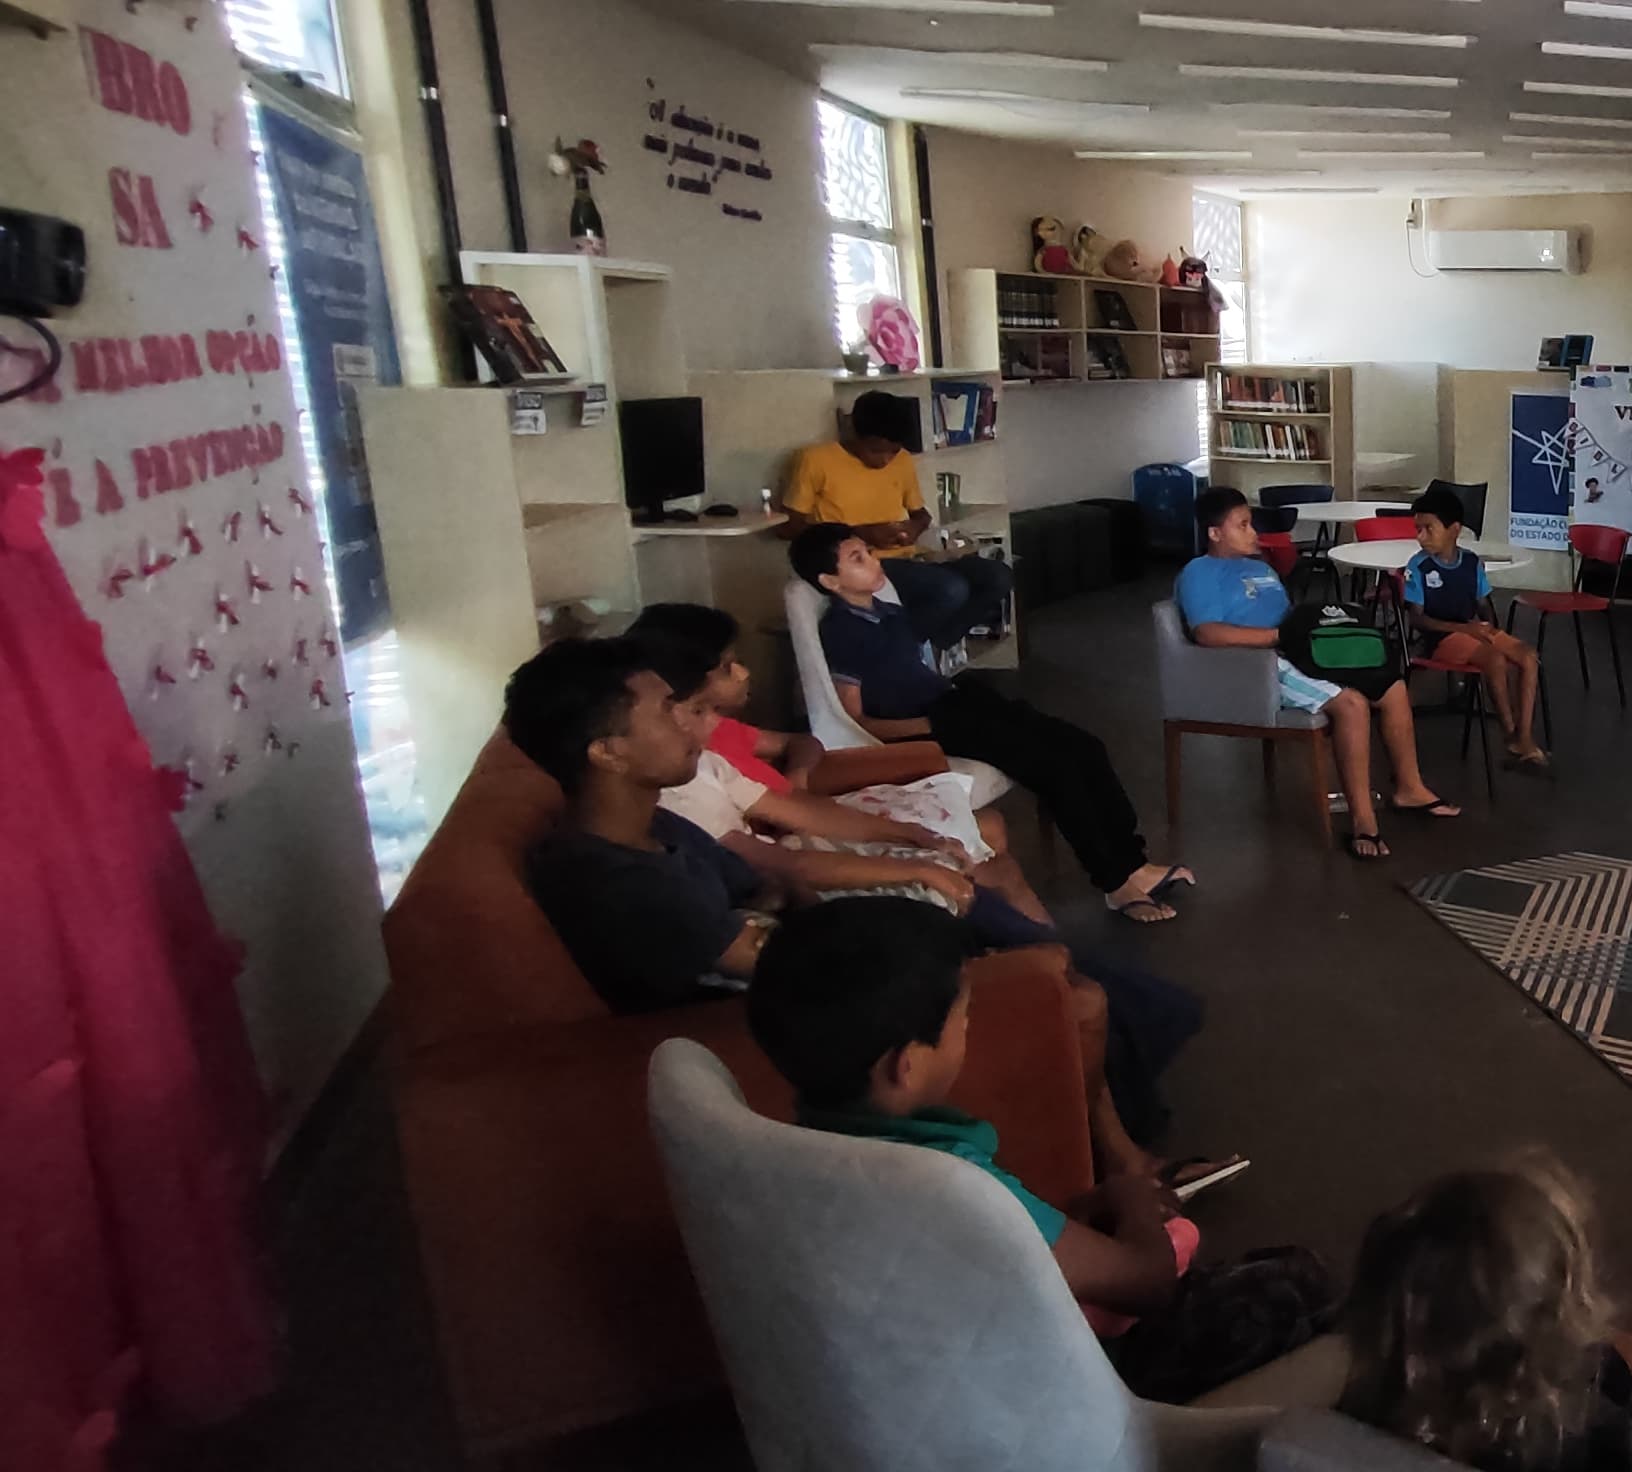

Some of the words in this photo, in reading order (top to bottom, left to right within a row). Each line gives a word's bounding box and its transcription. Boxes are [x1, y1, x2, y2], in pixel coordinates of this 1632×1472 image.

[89, 32, 191, 137] BRO
[107, 165, 175, 250] SA
[69, 332, 204, 394] MELHOR
[94, 457, 126, 515] A
[1510, 516, 1558, 530] FUNDAÇÃO
[1510, 529, 1524, 539] DO
[1525, 530, 1562, 541] ESTADO
